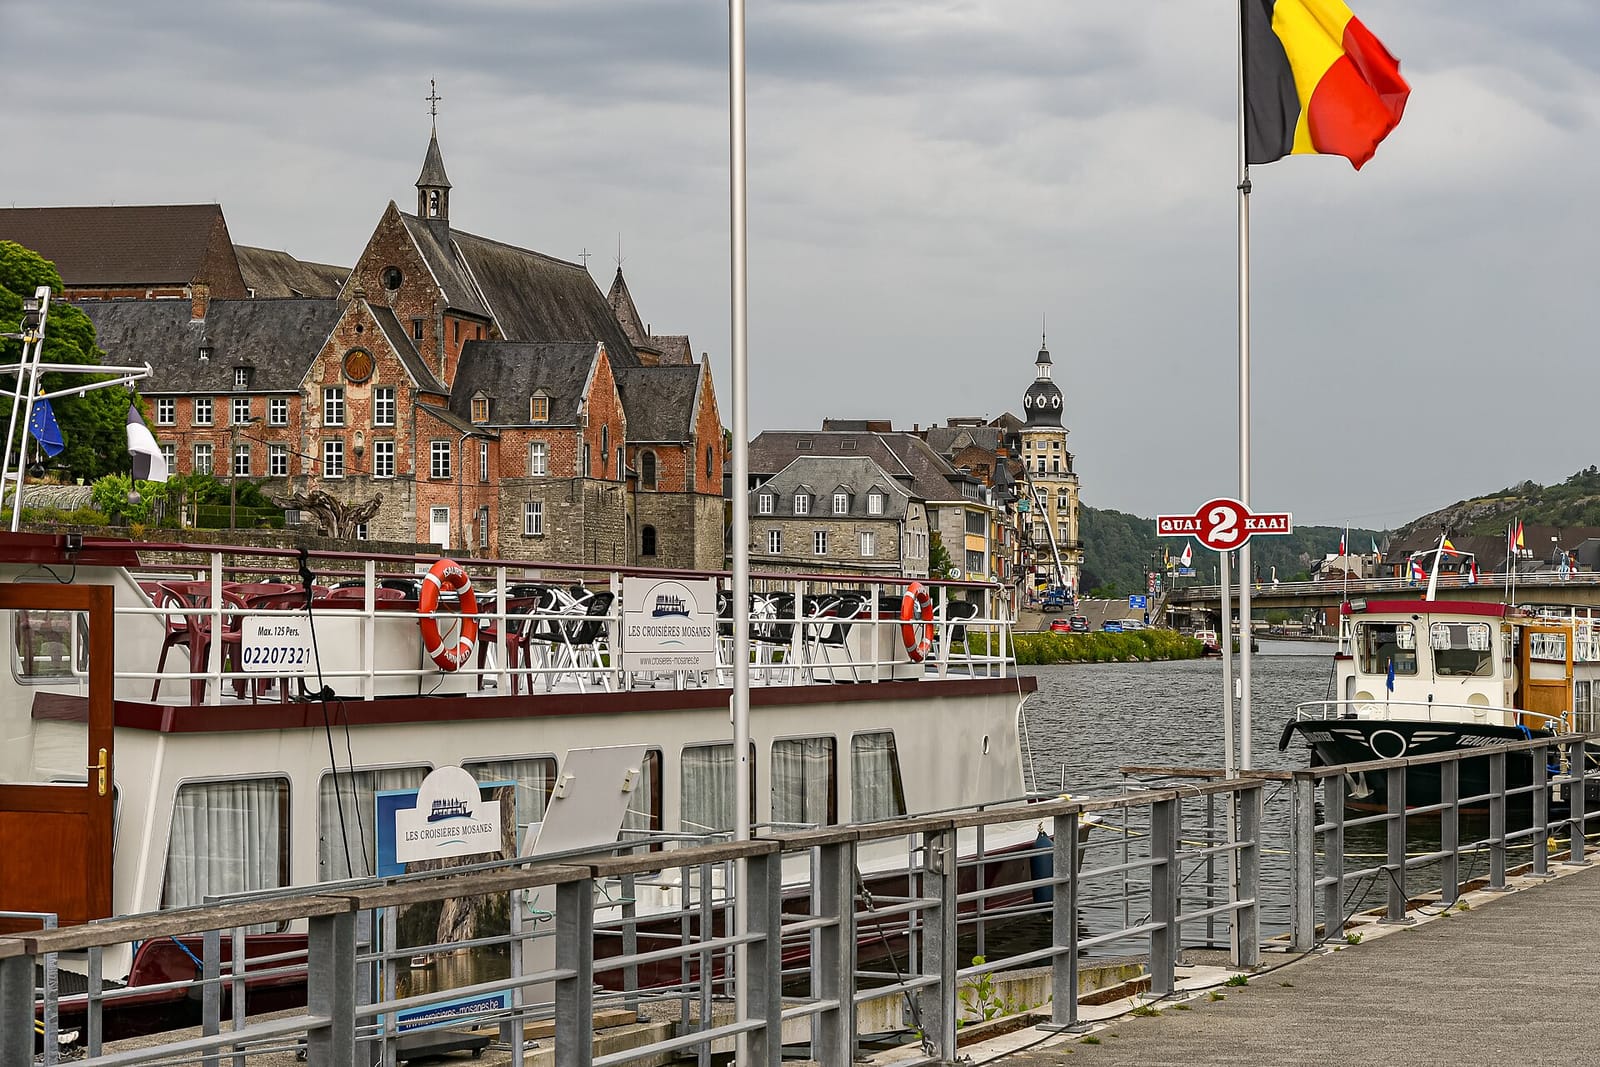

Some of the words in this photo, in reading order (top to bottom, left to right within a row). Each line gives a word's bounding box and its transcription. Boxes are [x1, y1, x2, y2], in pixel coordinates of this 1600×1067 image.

[1161, 519, 1202, 531] QUAI
[1208, 506, 1238, 542] 2
[1244, 518, 1286, 530] KAAI
[257, 625, 273, 636] Max.
[274, 625, 285, 636] 125
[285, 625, 300, 636] Pers.
[628, 625, 641, 637] LES
[642, 623, 681, 637] CROISIÈRES
[681, 625, 711, 637] MOSANES
[243, 646, 311, 664] 02207321
[405, 830, 419, 842] LES
[420, 825, 461, 840] CROISIÈRES
[461, 823, 493, 836] MOSANES
